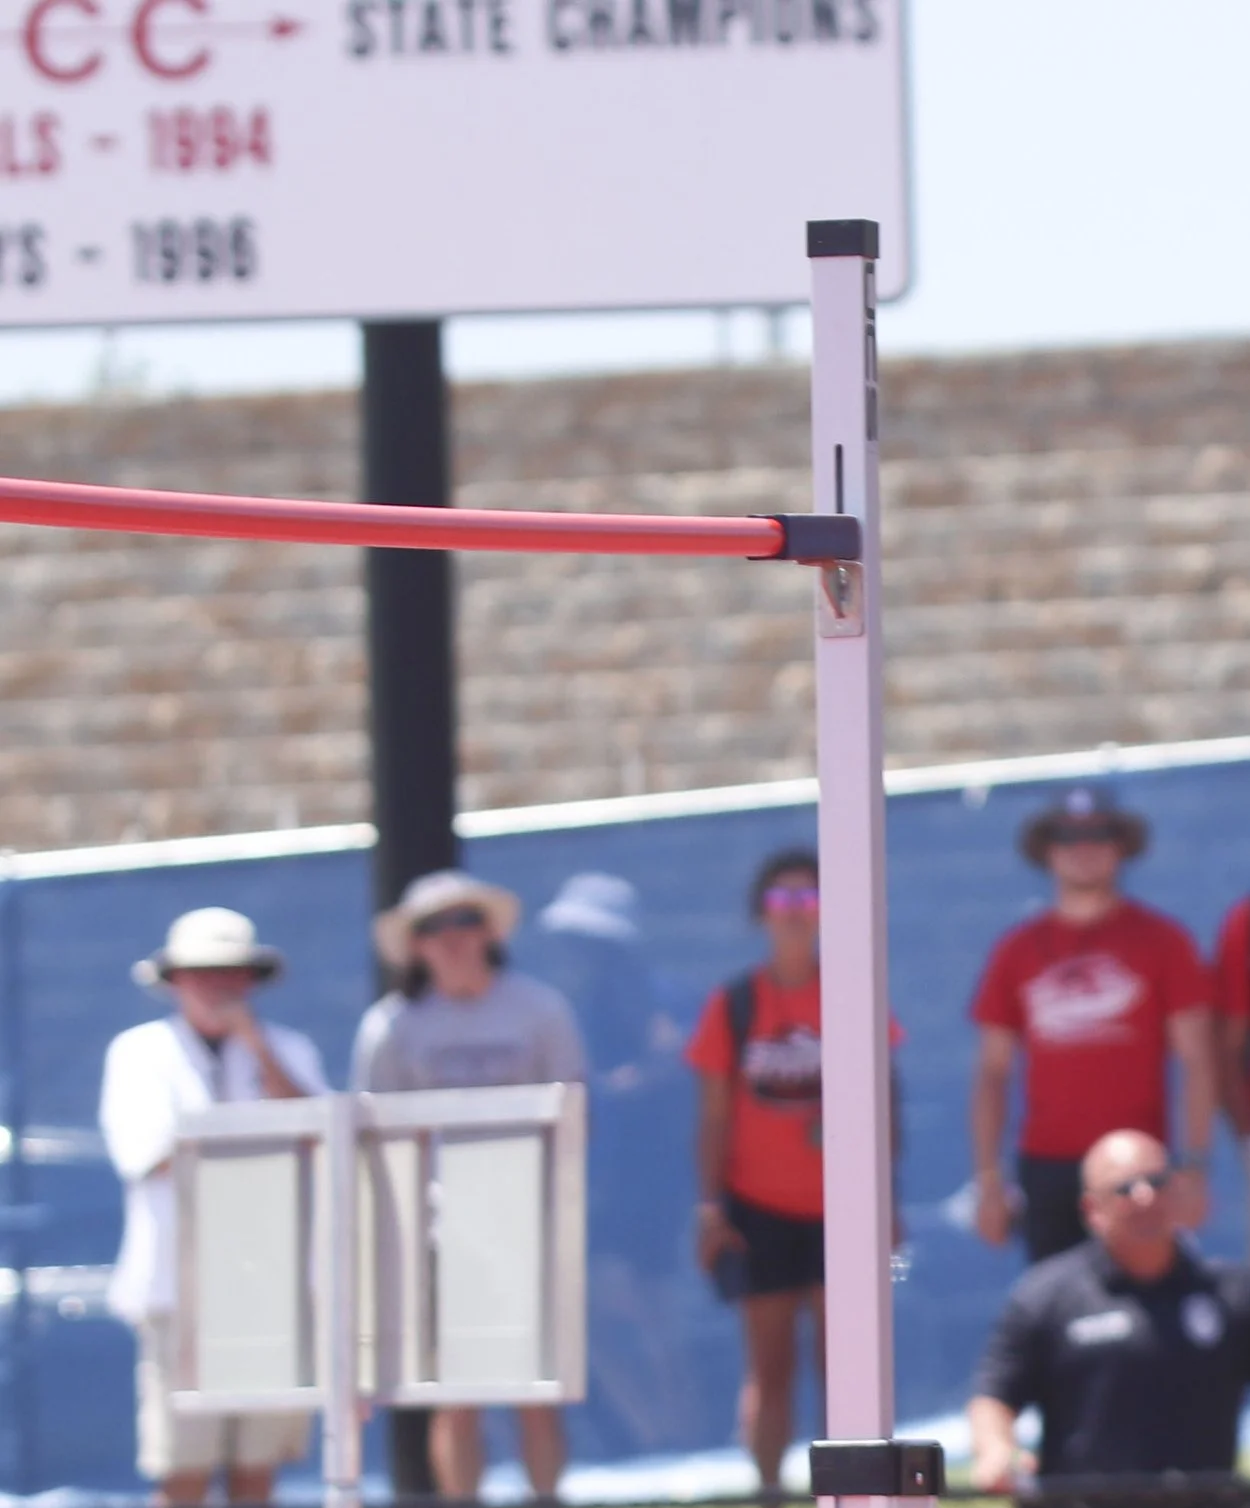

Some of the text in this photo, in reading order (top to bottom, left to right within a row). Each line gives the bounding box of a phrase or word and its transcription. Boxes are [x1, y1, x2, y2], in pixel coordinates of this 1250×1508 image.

[344, 0, 879, 57] STATE CHAMPIONS
[148, 105, 271, 172] 1994
[132, 215, 257, 284] 1996
